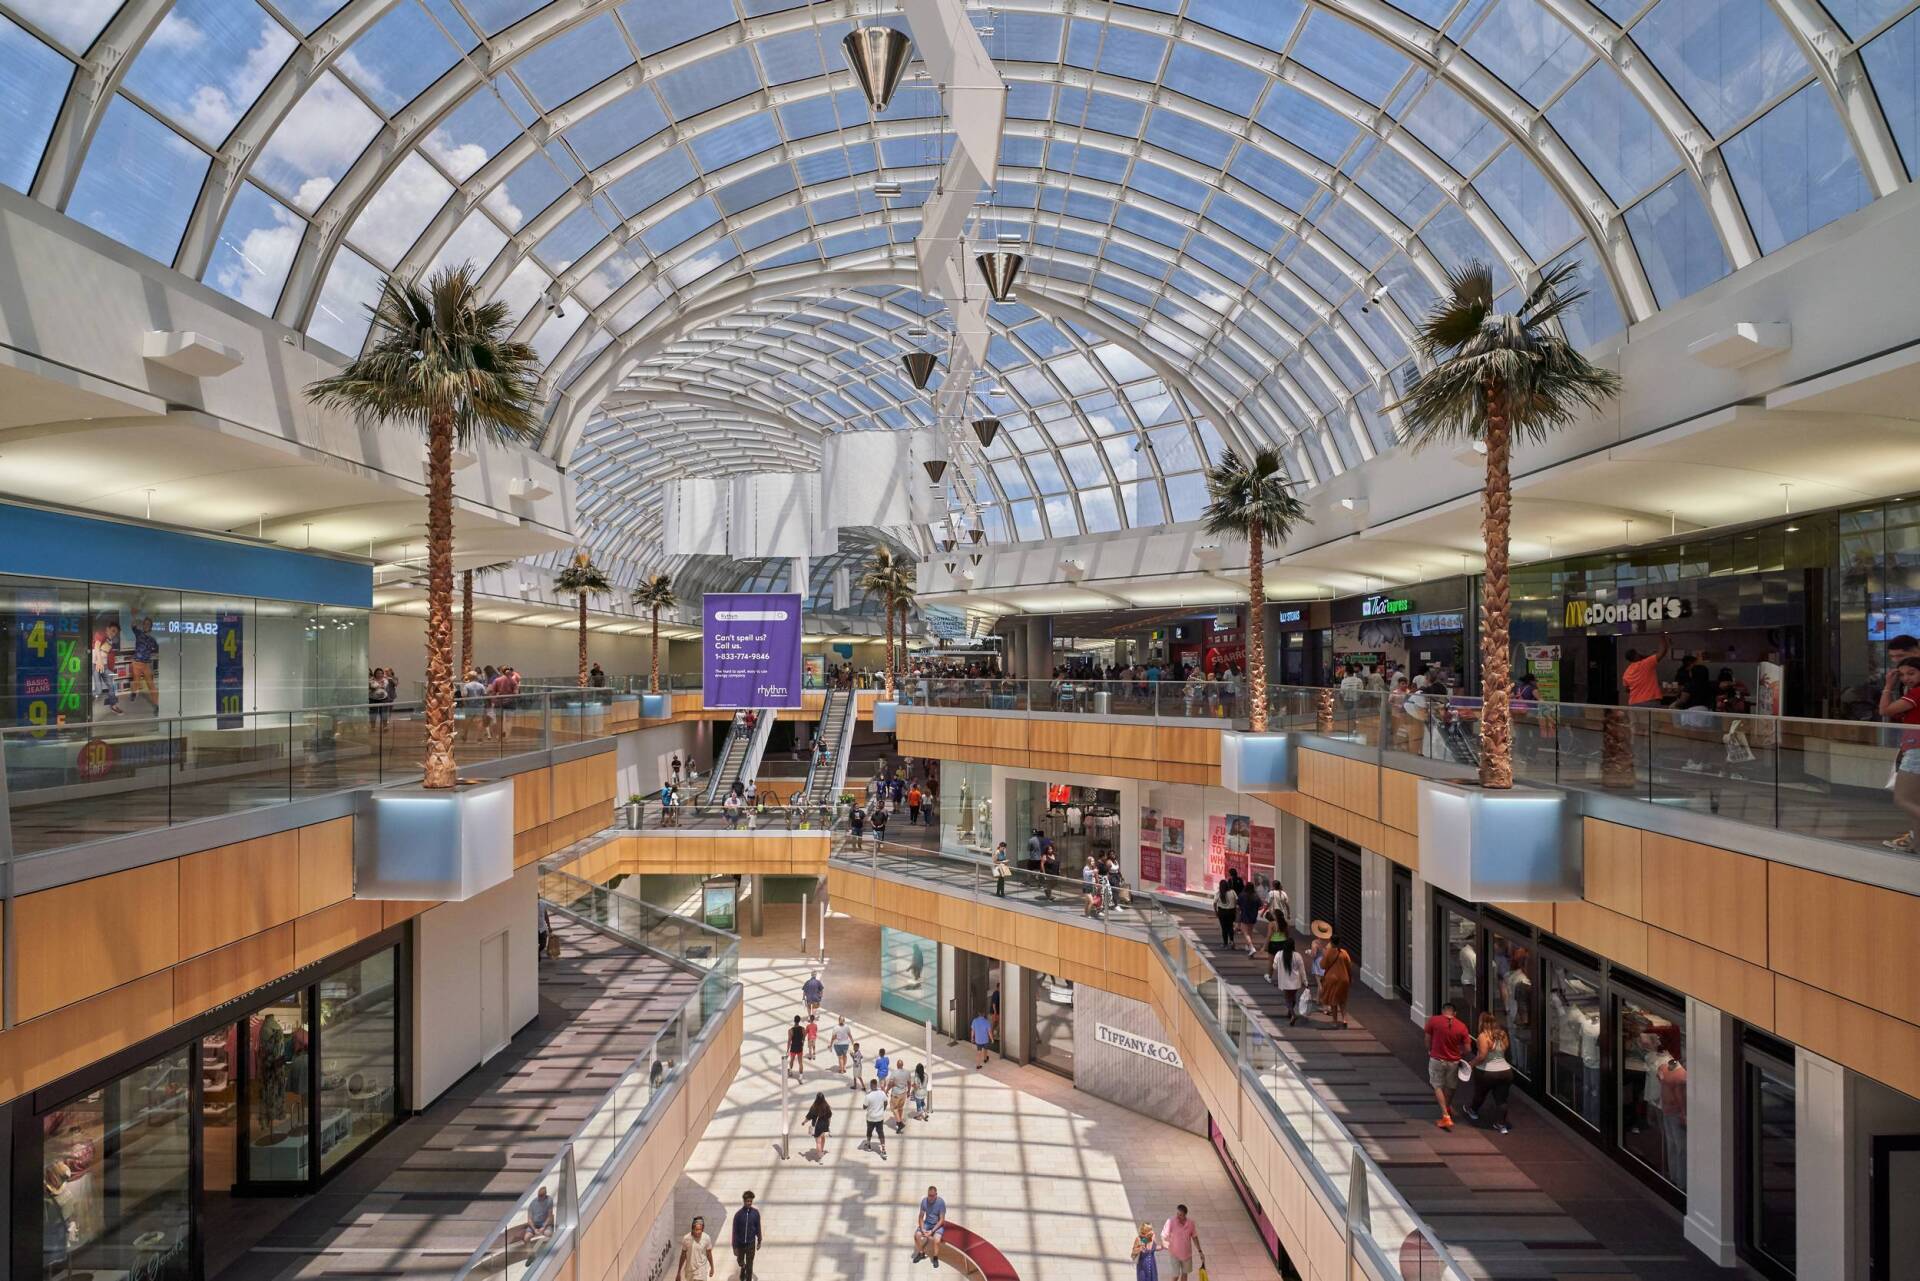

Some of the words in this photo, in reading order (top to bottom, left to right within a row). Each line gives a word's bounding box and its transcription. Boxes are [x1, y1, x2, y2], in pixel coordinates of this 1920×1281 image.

[1565, 597, 1681, 628] McDonald's
[27, 620, 48, 658] 4
[736, 634, 754, 642] spell
[223, 630, 237, 659] 4
[26, 678, 49, 687] BASIC
[27, 686, 50, 694] JEANS
[757, 684, 788, 697] rhythm
[1216, 827, 1226, 835] FU
[1213, 835, 1225, 845] BEL
[1212, 845, 1222, 854] TO
[1212, 865, 1223, 874] LIV
[1099, 1026, 1147, 1052] TIFFANY
[1147, 1043, 1157, 1057] &
